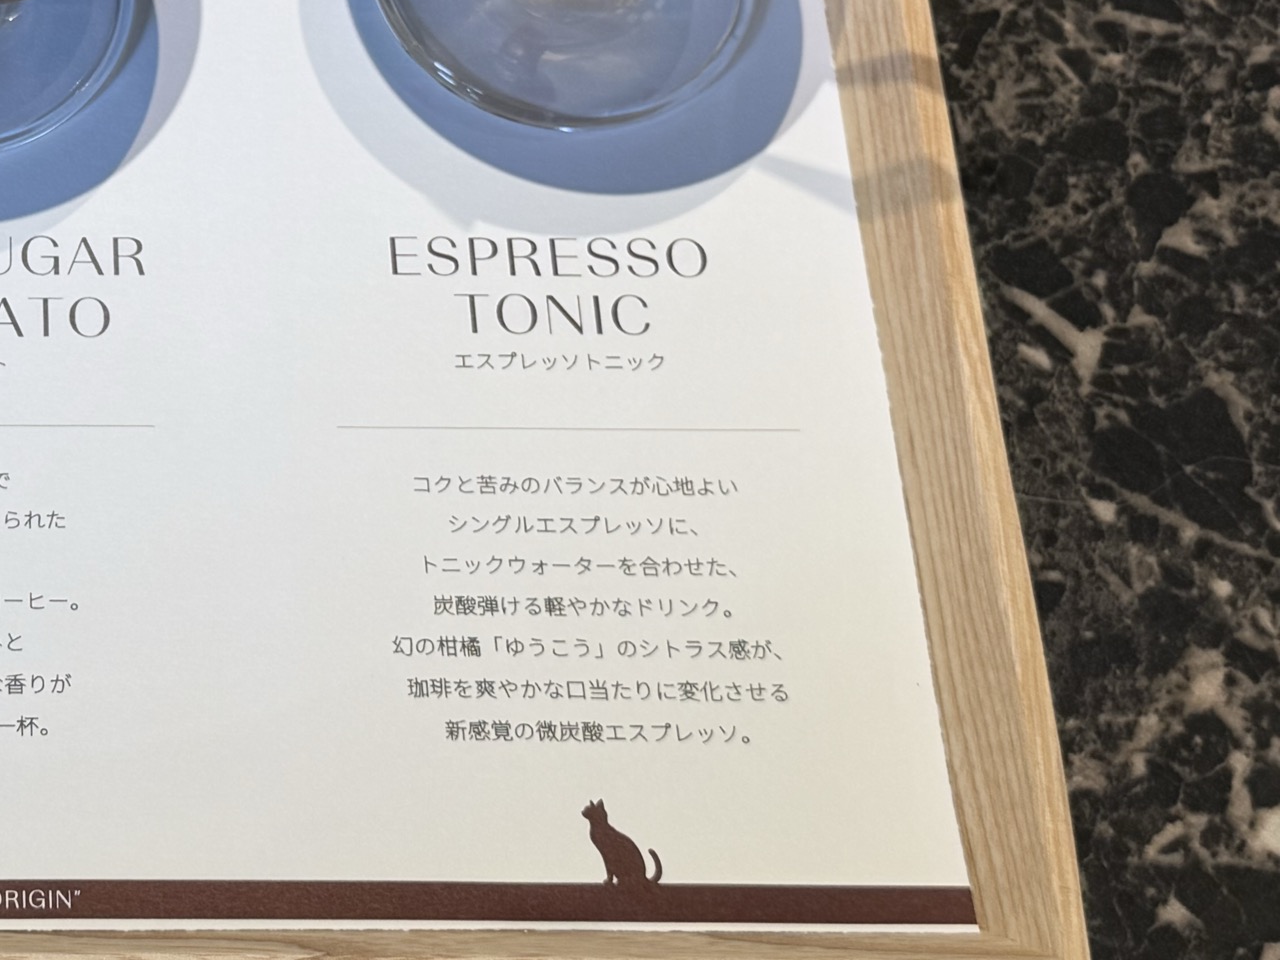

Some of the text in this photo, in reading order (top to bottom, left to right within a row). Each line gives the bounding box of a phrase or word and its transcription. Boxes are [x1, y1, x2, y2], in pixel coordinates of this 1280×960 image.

[388, 235, 708, 279] ESPRESSO
[453, 293, 651, 337] TONIC
[454, 351, 665, 372] エスプレッソトニック
[413, 474, 739, 497] コクと苦みのバランスが心地よい
[448, 514, 698, 537] シングルエスプレッソに、
[423, 554, 737, 578] トニックウォーターを合わせた、
[433, 594, 733, 619] 炭酸弾ける軽やかなドリンク。
[391, 635, 783, 661] 幻の柑橘「ゆうこう」のシトラス感が、
[406, 676, 789, 703] 珈琲を爽やかな口当たりに変化させる
[444, 719, 751, 745] 新感覚の微炭酸エスプレッソ。
